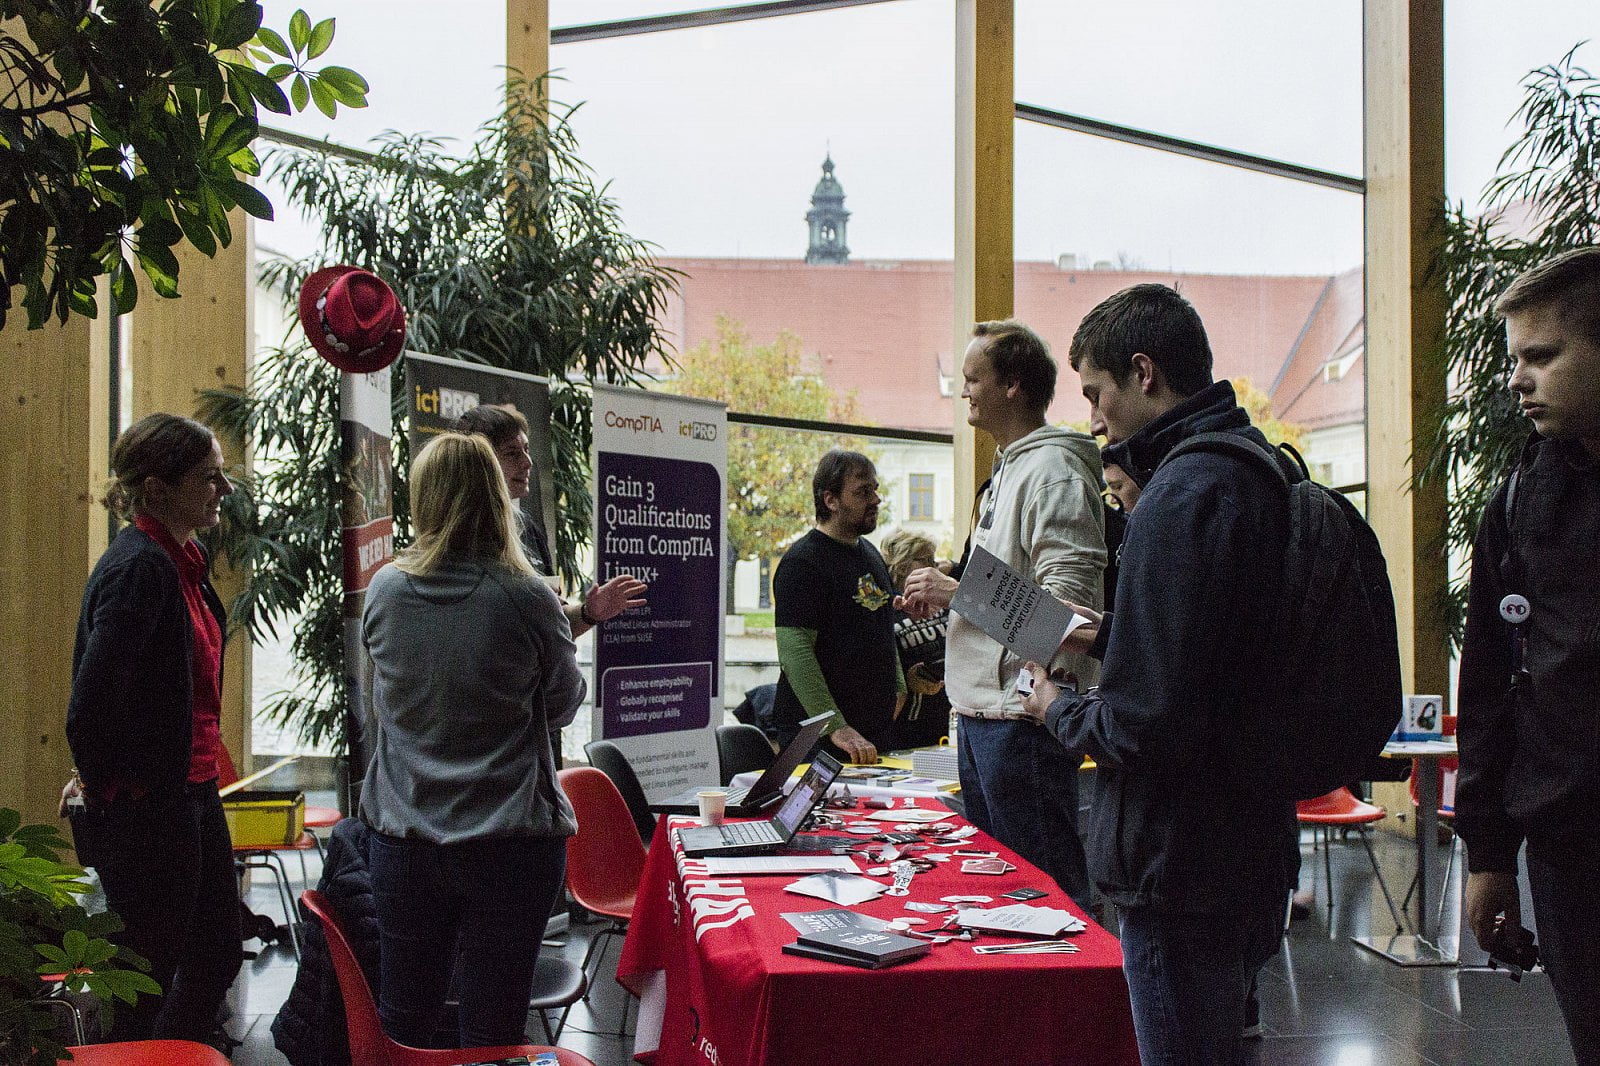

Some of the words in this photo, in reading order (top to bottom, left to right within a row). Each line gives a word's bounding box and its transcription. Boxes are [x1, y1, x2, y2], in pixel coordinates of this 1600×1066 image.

[604, 410, 664, 434] CompTIA
[679, 420, 717, 441] ictPRO
[605, 475, 642, 497] Gain
[646, 481, 655, 502] 3
[605, 504, 711, 531] Qualifications
[604, 531, 644, 555] from
[648, 535, 714, 561] CompTIA
[990, 570, 1012, 608] PURPOSE
[1000, 576, 1021, 611] PASSION
[1003, 582, 1029, 630] COMMUNITY
[1007, 588, 1038, 643] OPPORTUNITY
[650, 676, 693, 689] employability
[648, 711, 663, 722] your
[664, 708, 680, 718] skills
